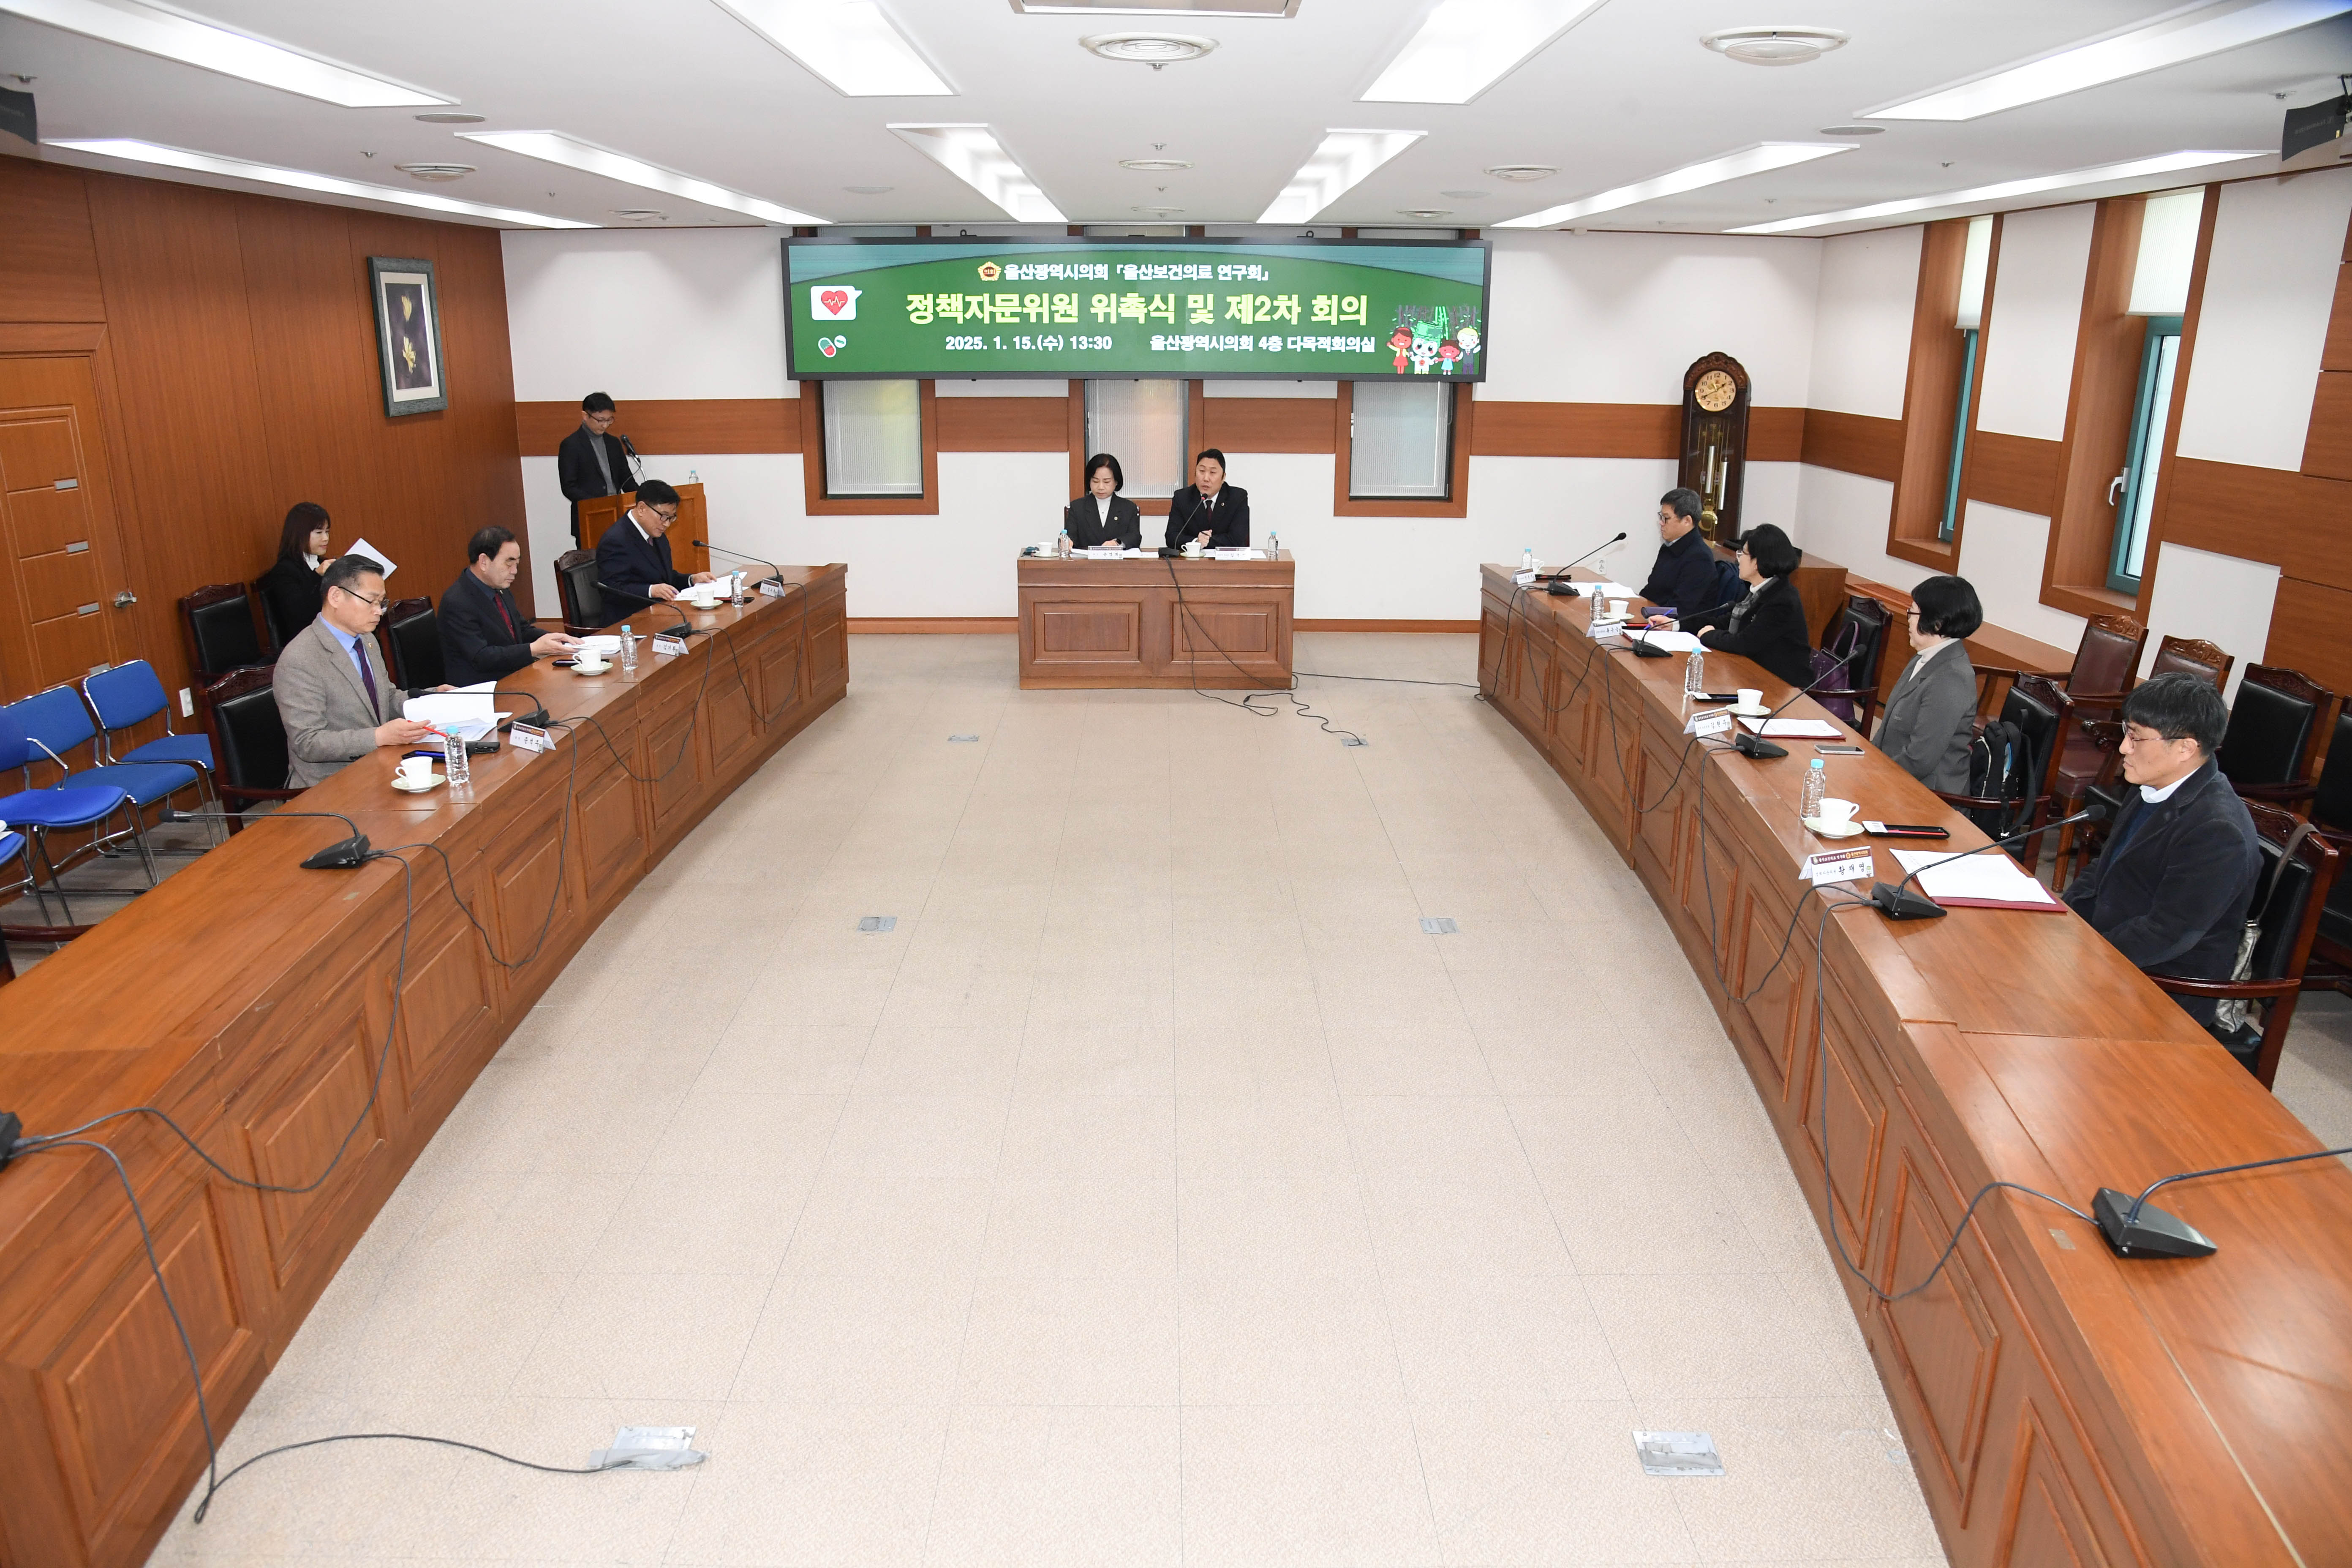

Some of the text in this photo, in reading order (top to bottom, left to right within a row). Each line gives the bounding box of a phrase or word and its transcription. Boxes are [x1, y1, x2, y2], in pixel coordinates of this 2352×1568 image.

[1004, 264, 1108, 280] 울산광역시의회
[906, 292, 1367, 326] 정책자문위원 위촉식 및 제2차 회의
[945, 335, 1112, 351] 2025. 1. 15.(수) 13:30
[1150, 335, 1375, 353] 울산광역시의회 4층 다목적회의실
